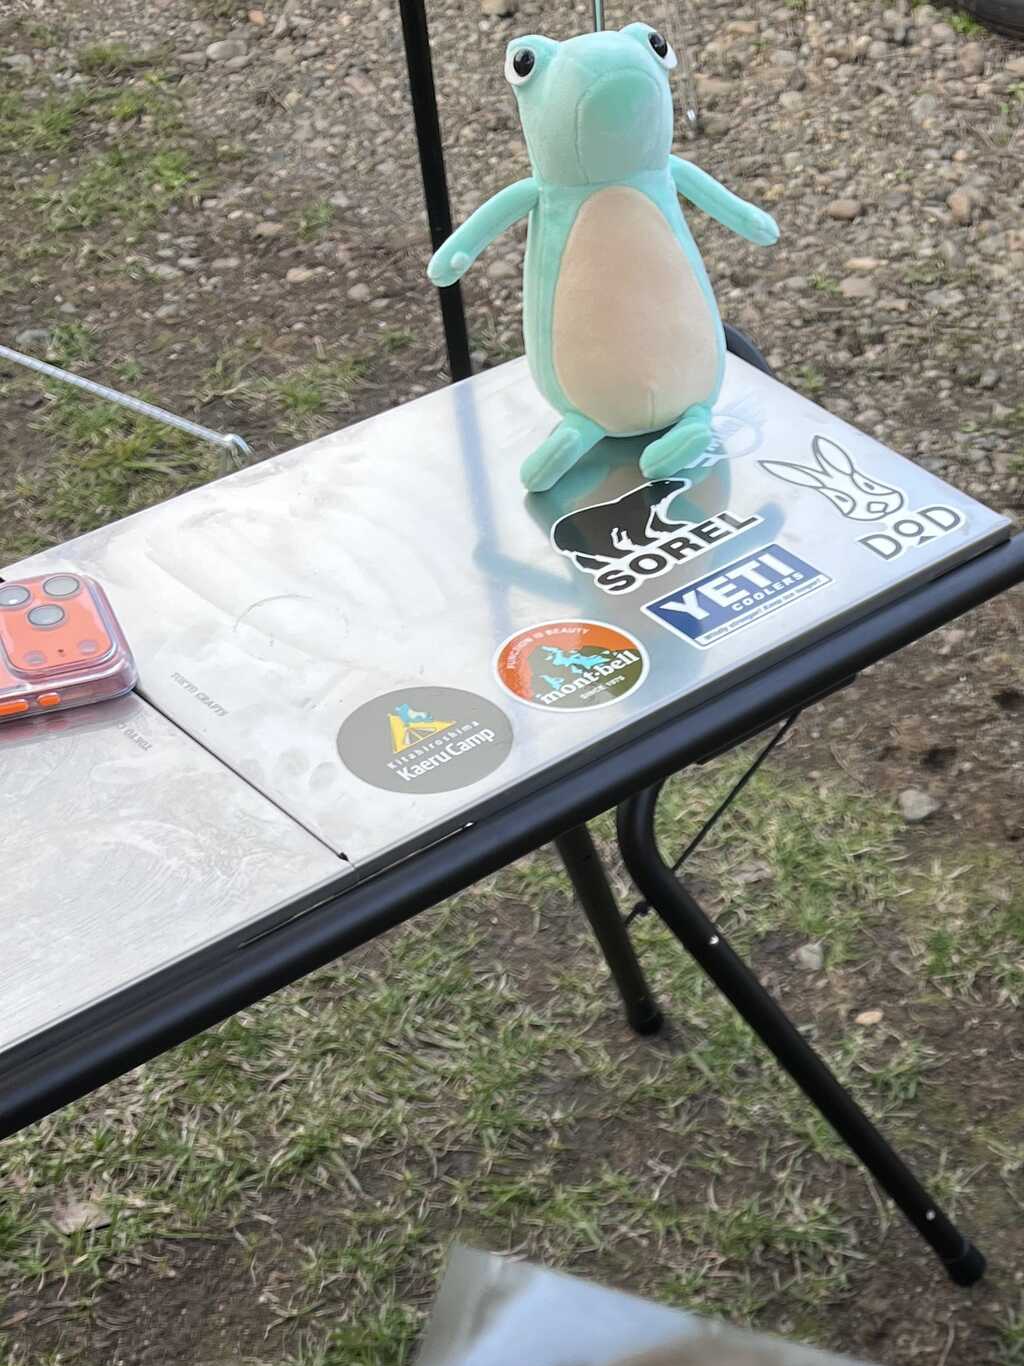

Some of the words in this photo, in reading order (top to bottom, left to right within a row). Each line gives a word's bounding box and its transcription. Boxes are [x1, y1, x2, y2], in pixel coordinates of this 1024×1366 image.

[597, 511, 758, 592] SOREL
[857, 505, 960, 560] DOD
[659, 553, 796, 622] YETI
[731, 571, 804, 612] COOLERS
